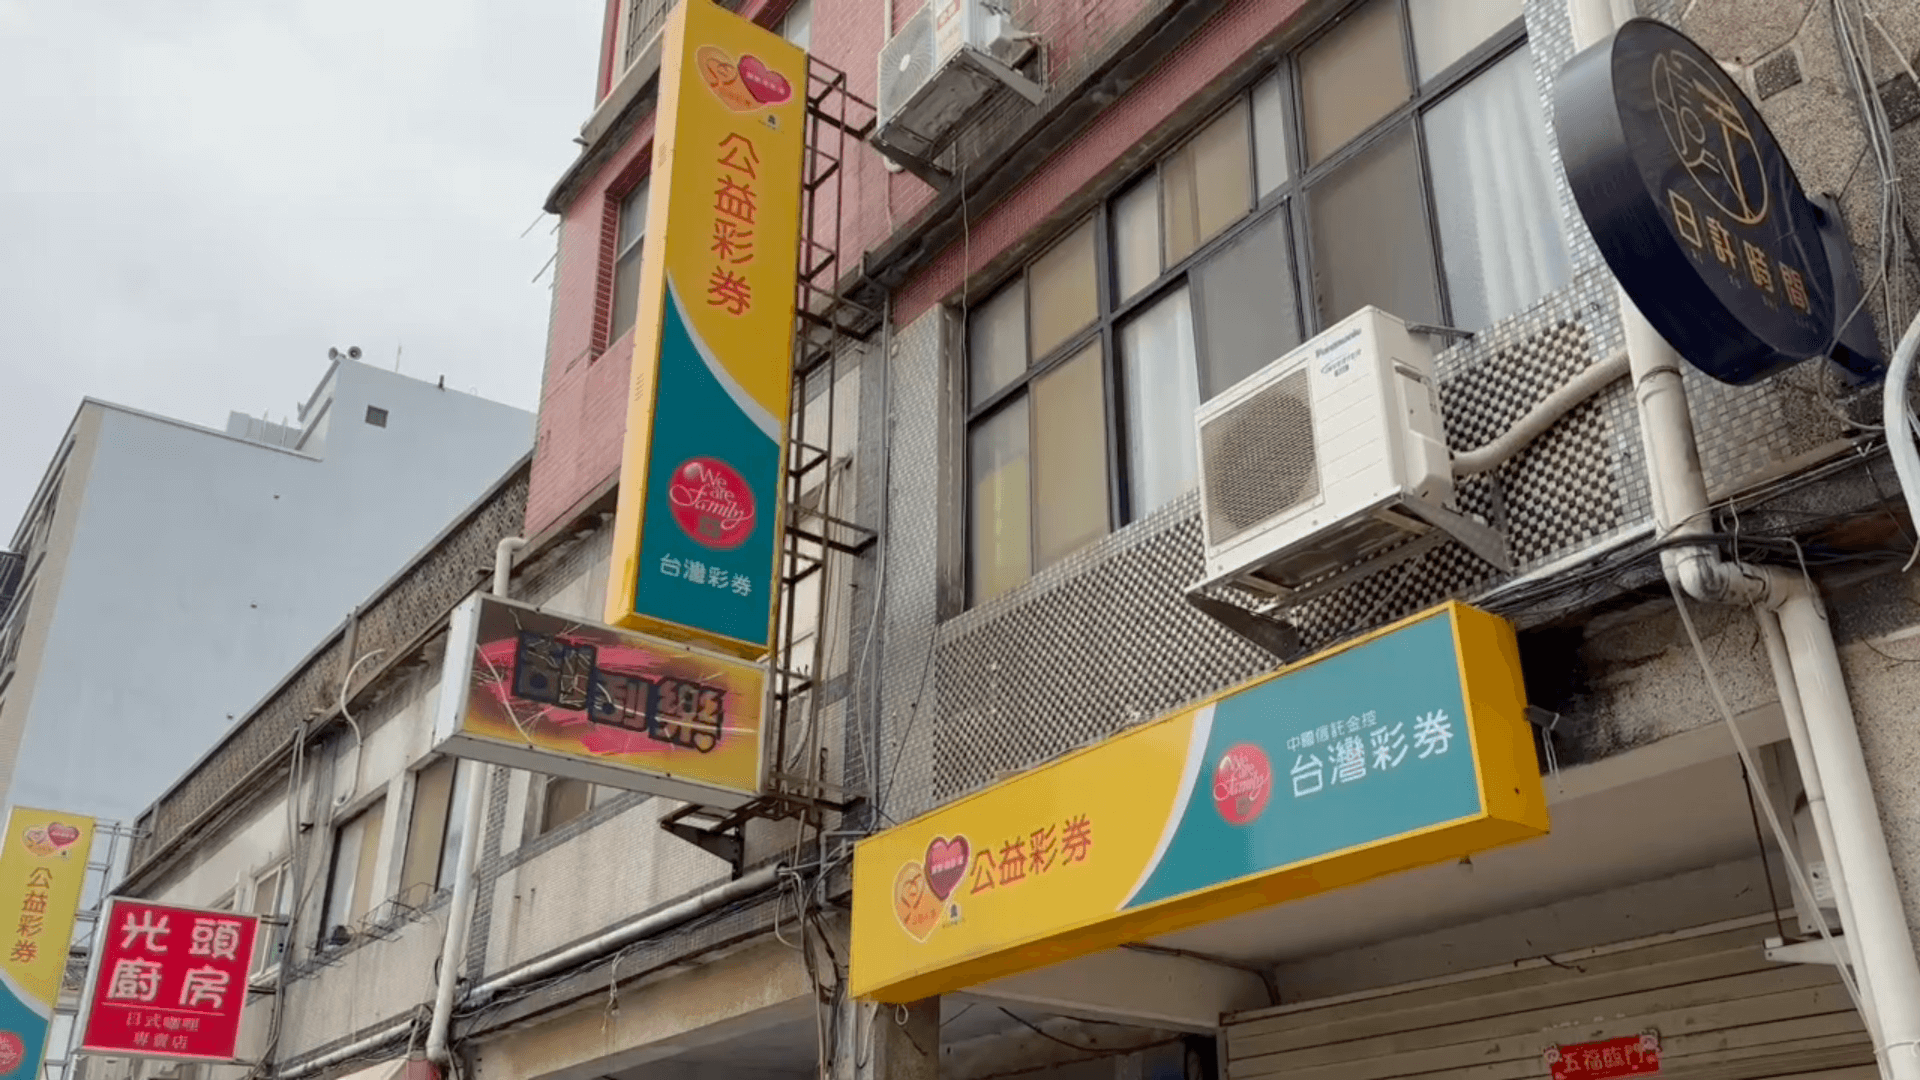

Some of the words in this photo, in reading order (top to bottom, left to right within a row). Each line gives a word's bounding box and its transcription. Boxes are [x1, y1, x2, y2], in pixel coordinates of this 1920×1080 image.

[707, 132, 760, 316] 公益彩券
[694, 463, 727, 489] We
[709, 487, 735, 504] are
[669, 484, 755, 531] Family
[659, 553, 752, 598] 台灣彩券
[1290, 708, 1454, 798] 台灣彩券
[969, 813, 1092, 896] 公益彩券
[10, 866, 53, 964] 公益彩券
[120, 910, 243, 961] 光頭
[106, 956, 231, 1009] 廚房
[1561, 1043, 1645, 1074] 五福臨門
